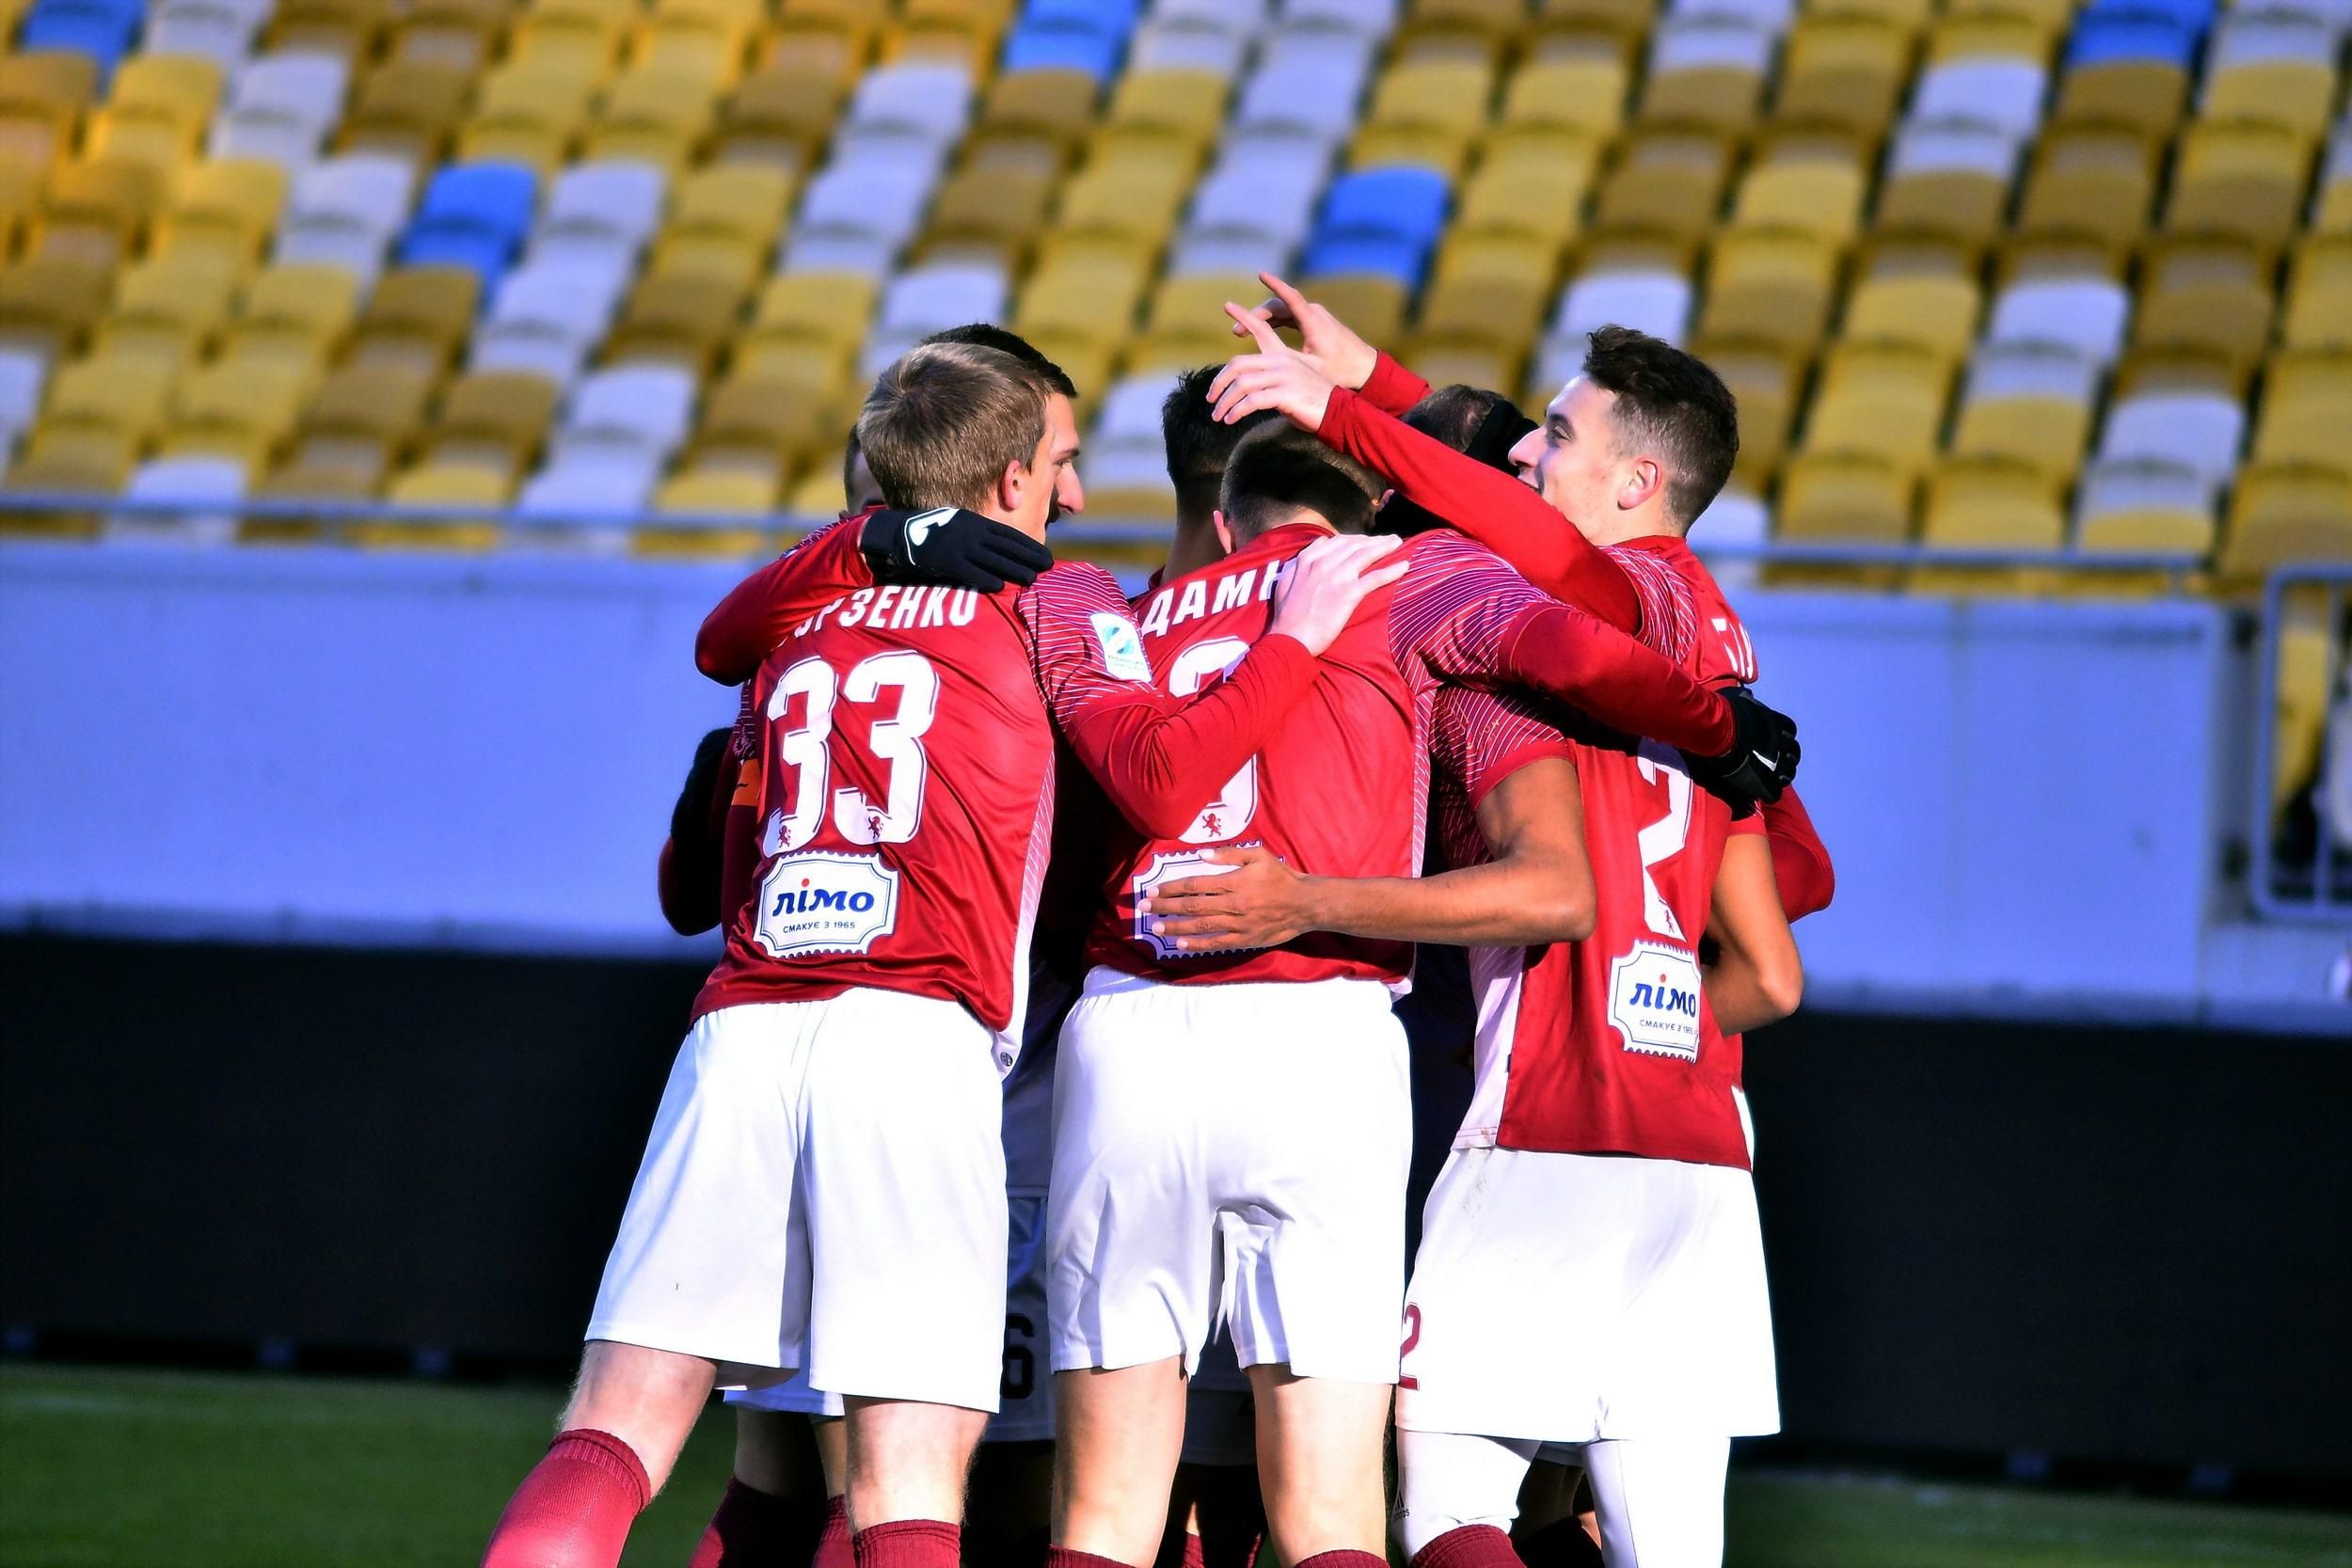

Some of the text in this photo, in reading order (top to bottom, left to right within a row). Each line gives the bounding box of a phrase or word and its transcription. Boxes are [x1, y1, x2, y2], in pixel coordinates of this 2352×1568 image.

[763, 649, 940, 858] 33
[1636, 736, 1694, 942] 2
[771, 878, 875, 917] лімо
[783, 921, 820, 933] СМАКУЄ
[1629, 973, 1696, 1018] лімо
[1640, 1019, 1676, 1031] СМАКУЄ
[1002, 1312, 1034, 1400] 6
[1399, 1301, 1422, 1391] 2
